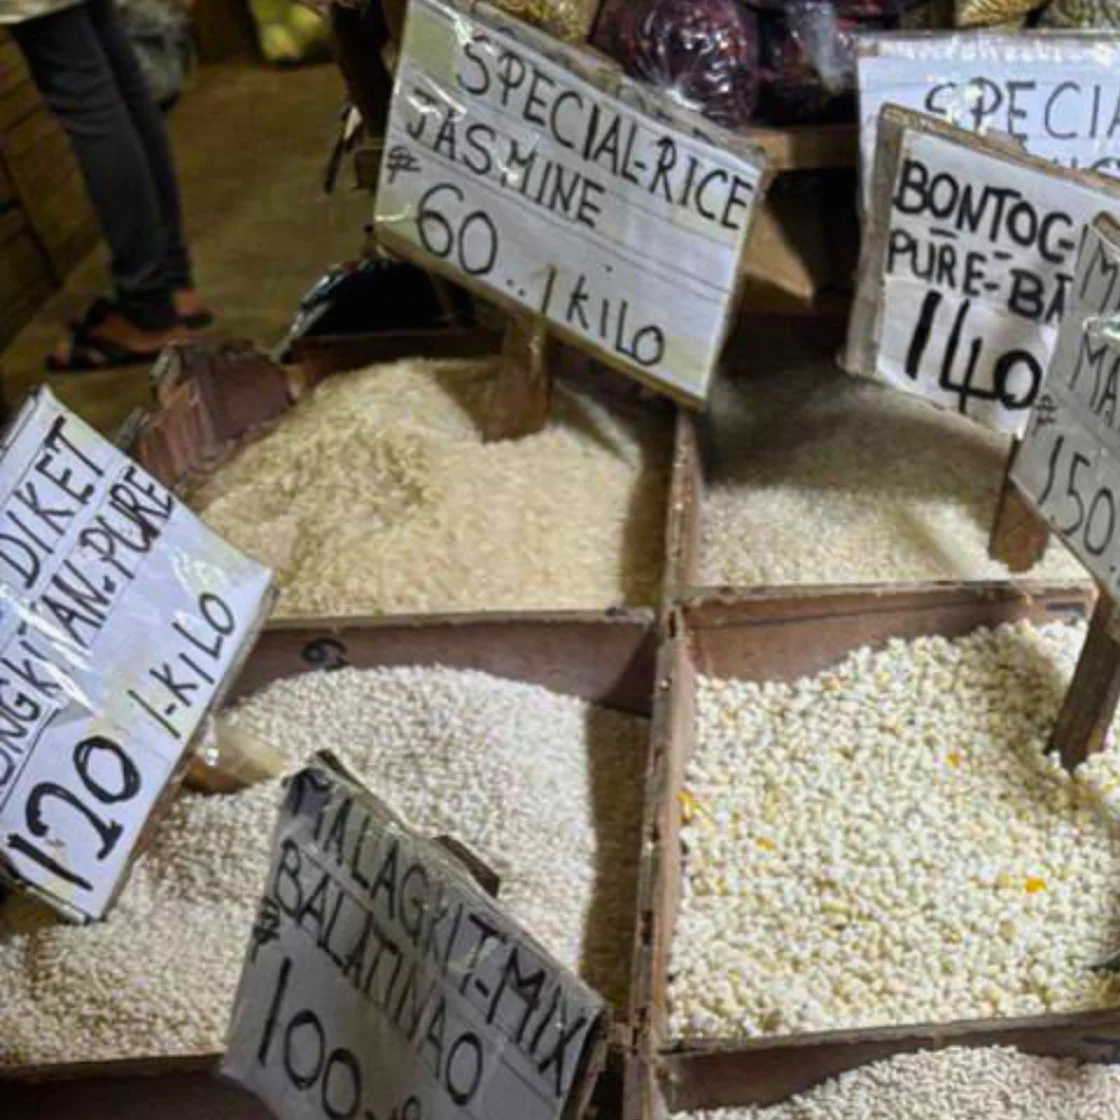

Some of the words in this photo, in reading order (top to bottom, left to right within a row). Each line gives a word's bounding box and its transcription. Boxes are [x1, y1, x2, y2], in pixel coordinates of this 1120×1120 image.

[405, 87, 607, 230] JASMINE
[456, 34, 756, 232] SPECIAL-RICE
[904, 289, 1044, 418] 140
[0, 414, 105, 590] DIKET
[7, 735, 141, 892] 120
[274, 838, 483, 1107] BALATINAO
